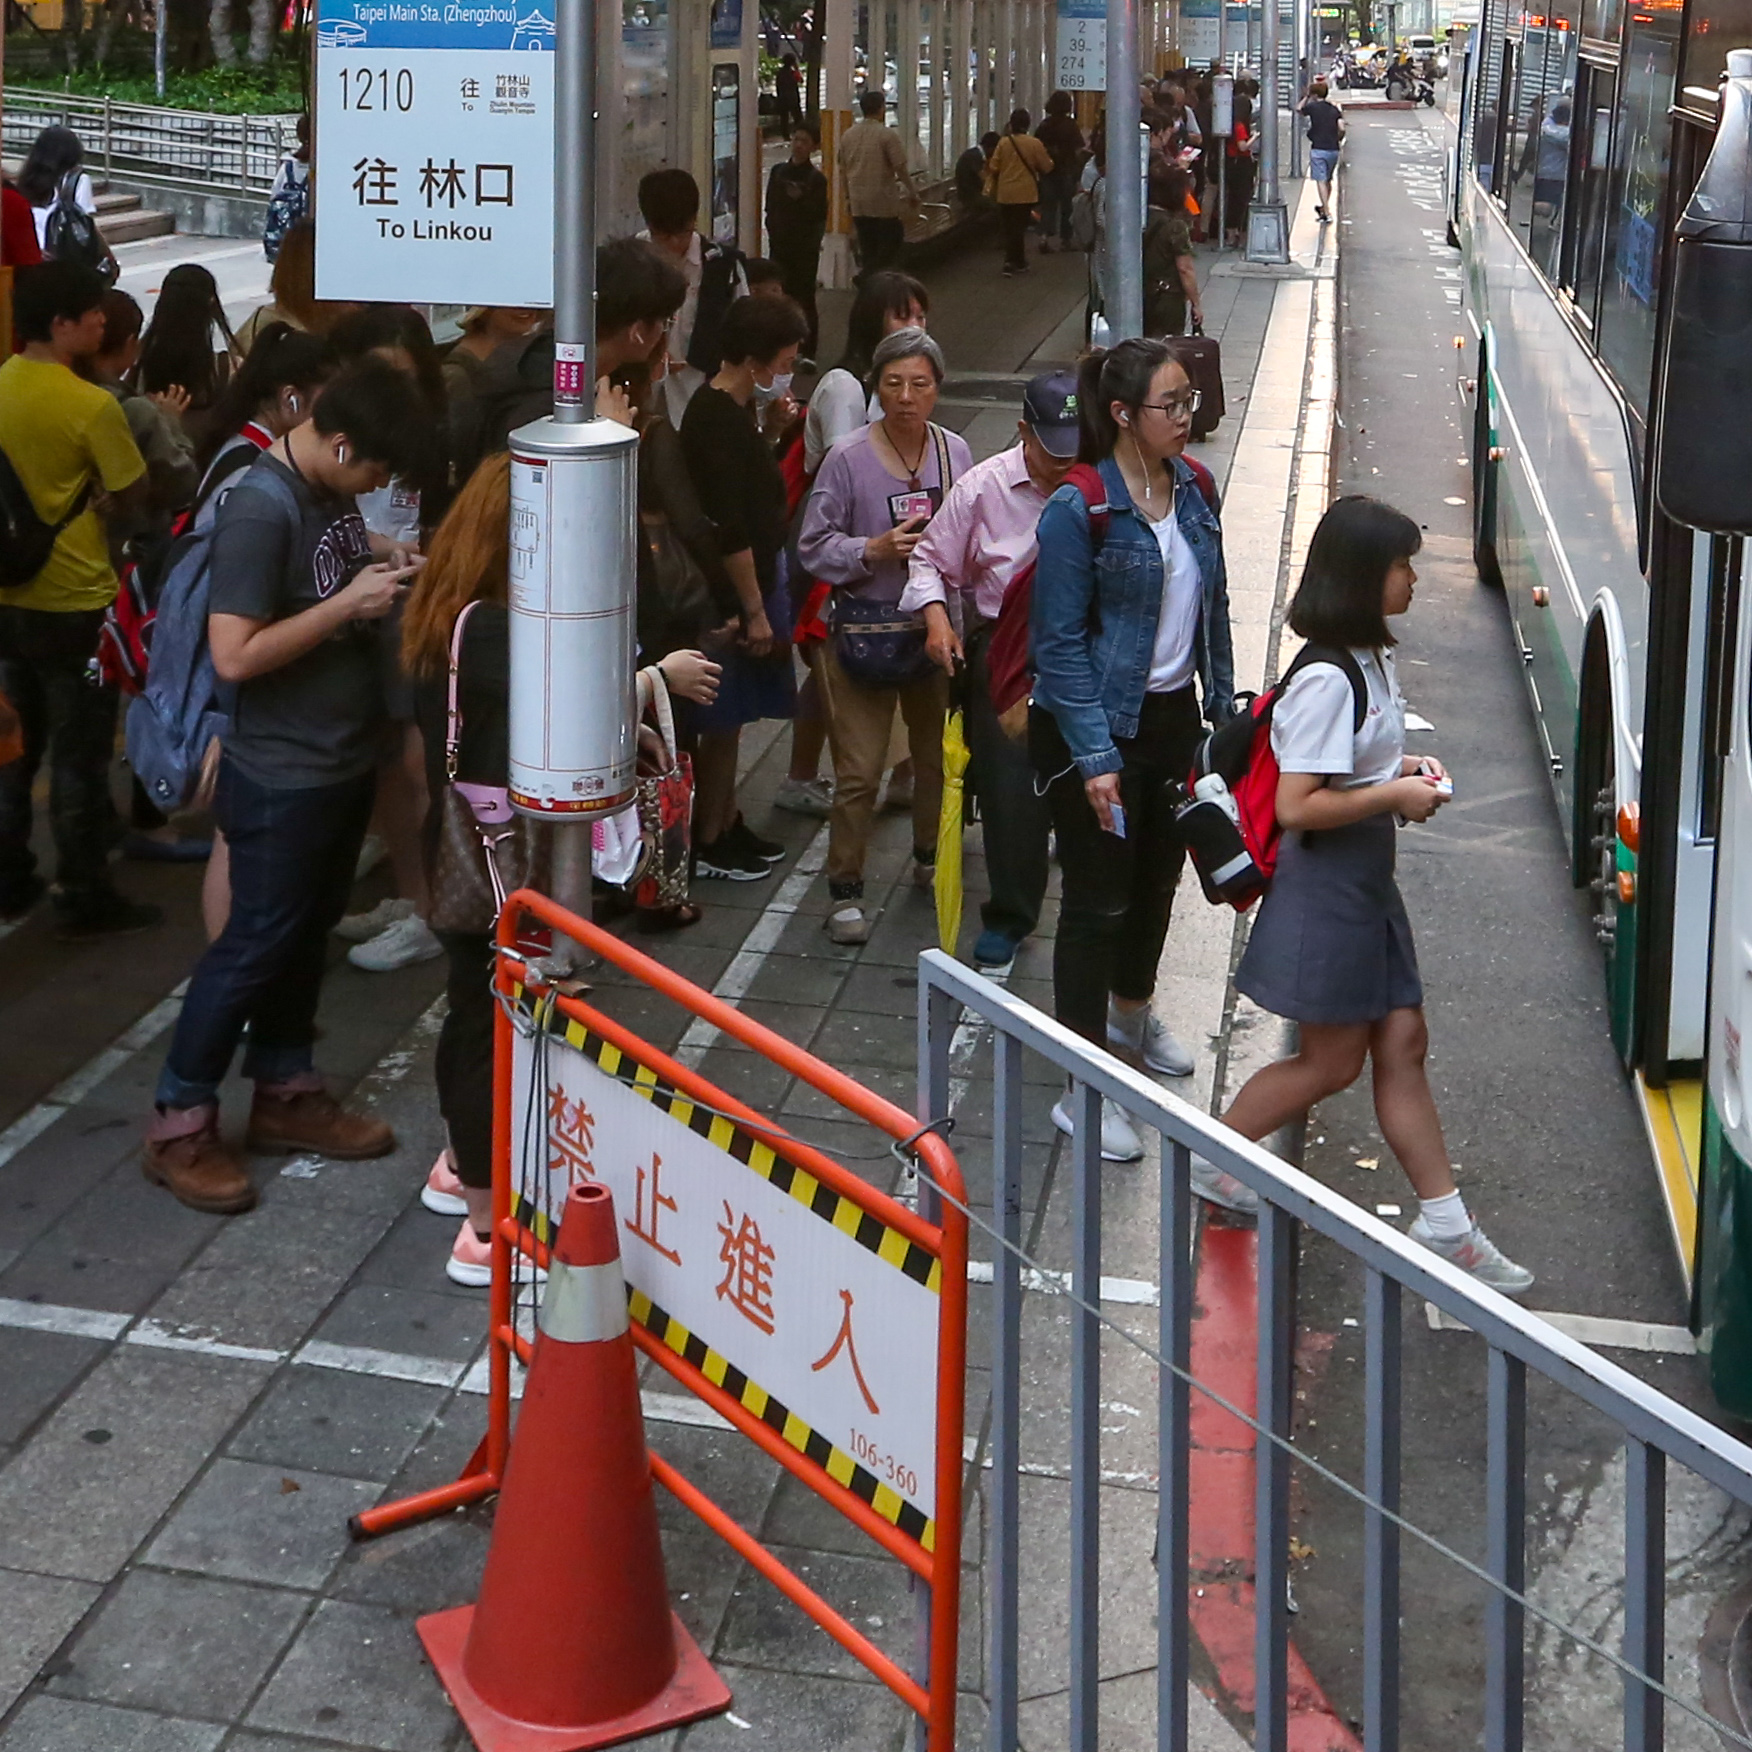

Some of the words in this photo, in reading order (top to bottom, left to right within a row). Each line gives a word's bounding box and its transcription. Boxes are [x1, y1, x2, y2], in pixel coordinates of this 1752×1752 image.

[353, 3, 387, 25] Taipei
[389, 4, 418, 22] Main
[420, 3, 442, 22] Sta.
[444, 3, 518, 27] (Zhengzhou)
[1078, 20, 1086, 34] 2
[1061, 56, 1085, 70] 274
[339, 67, 414, 112] 1210
[460, 77, 480, 99] 往
[1060, 73, 1085, 88] 669
[461, 102, 474, 112] To
[352, 157, 514, 209] 往林口
[376, 218, 405, 239] To
[413, 219, 492, 241] Linkou
[548, 1082, 880, 1415] 禁止進入
[850, 1428, 917, 1497] 106-360
